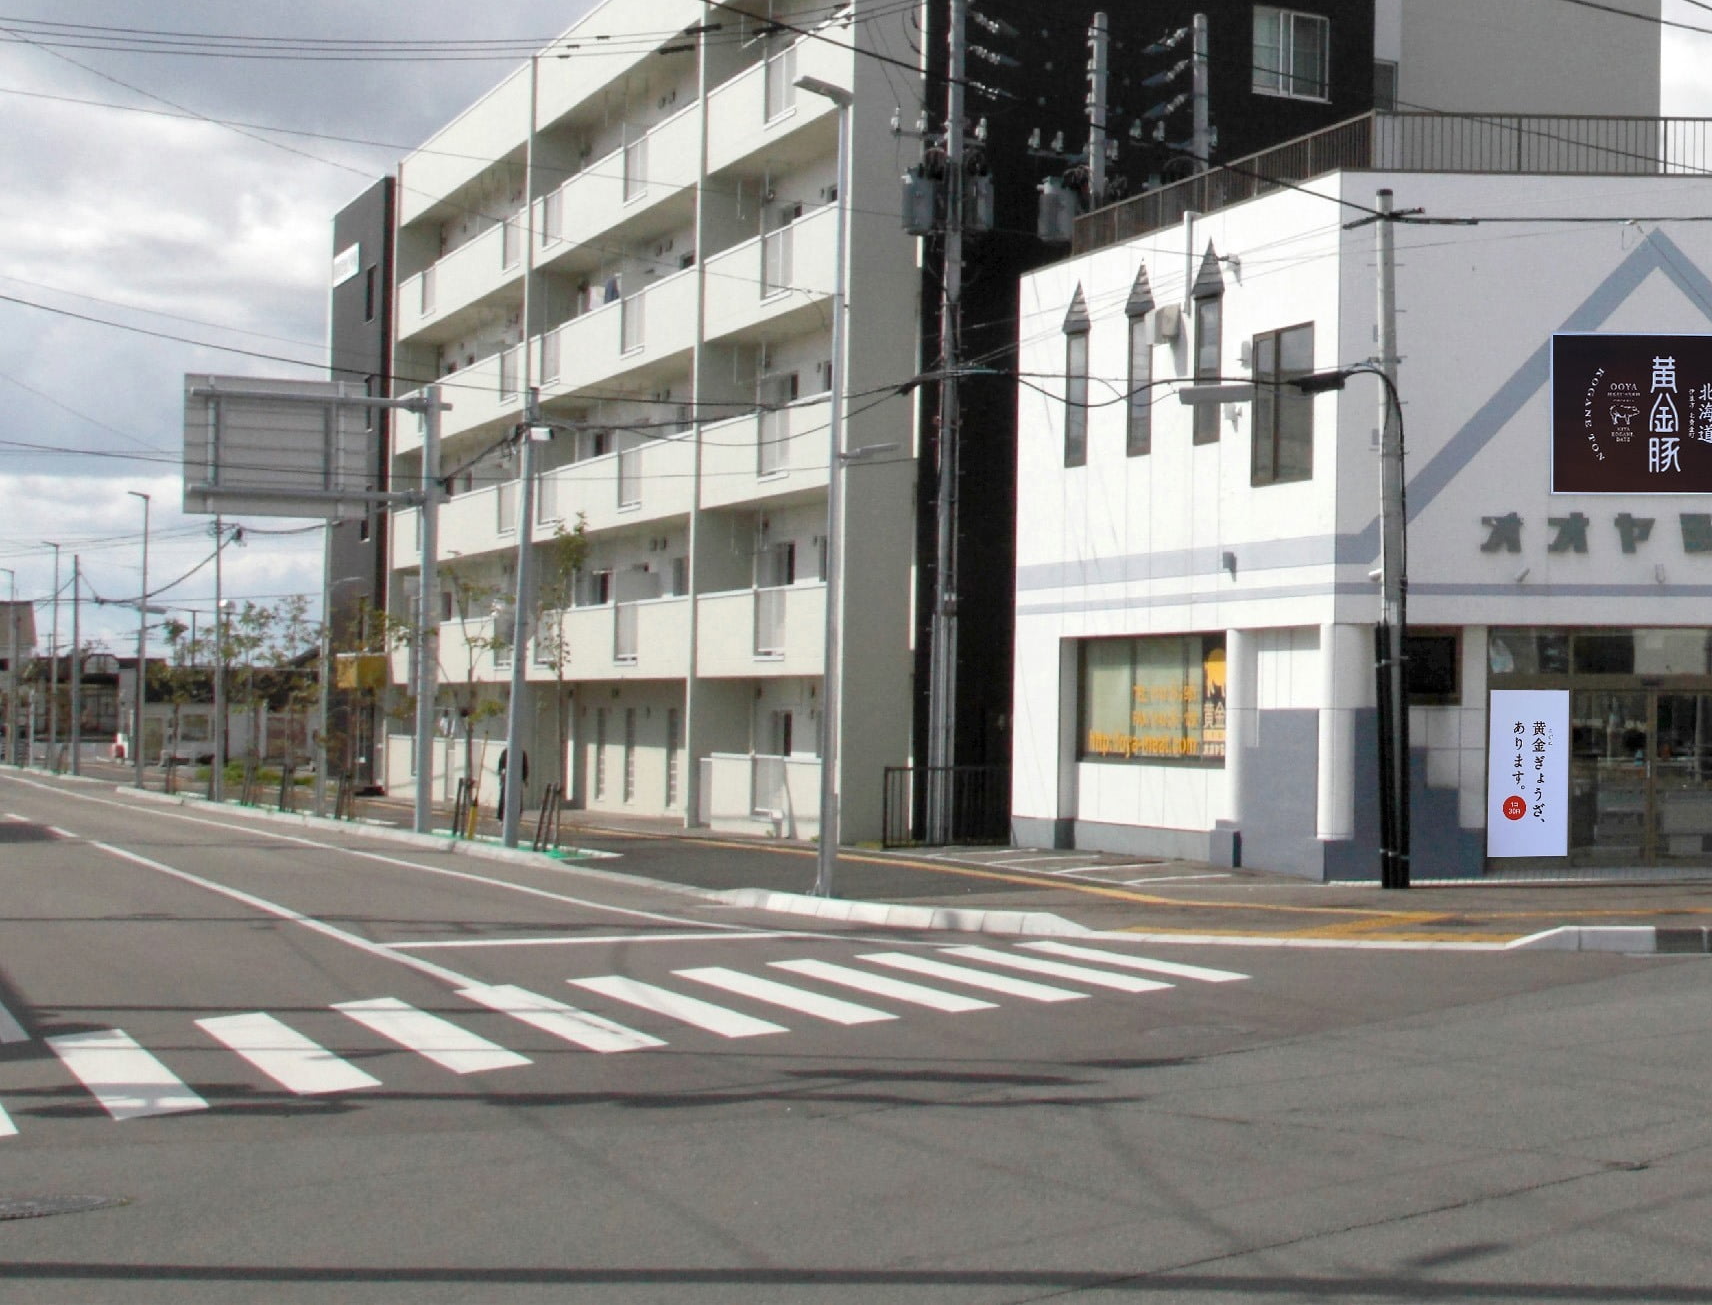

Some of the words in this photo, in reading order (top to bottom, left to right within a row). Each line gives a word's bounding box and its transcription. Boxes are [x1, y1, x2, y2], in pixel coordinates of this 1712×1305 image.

[1610, 382, 1638, 391] OOYA
[1648, 355, 1681, 473] 黄金豚
[1511, 720, 1526, 790] あります。
